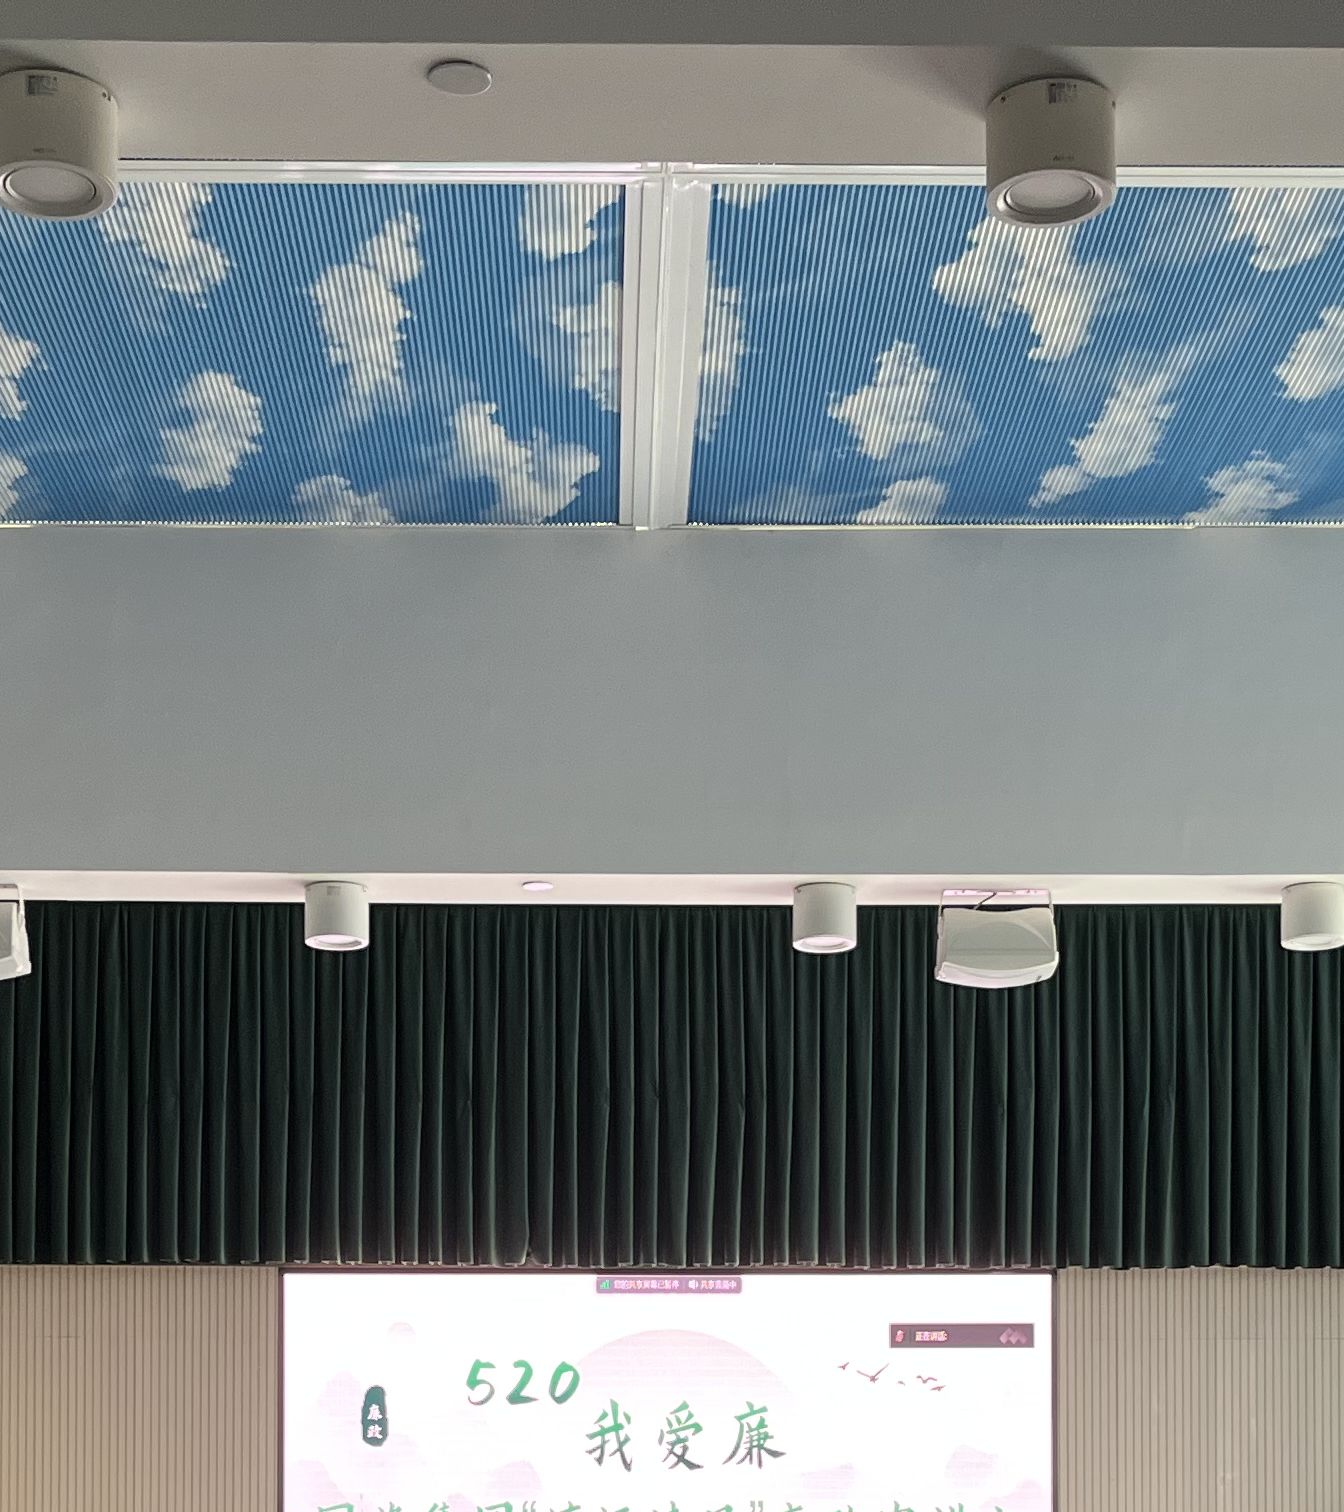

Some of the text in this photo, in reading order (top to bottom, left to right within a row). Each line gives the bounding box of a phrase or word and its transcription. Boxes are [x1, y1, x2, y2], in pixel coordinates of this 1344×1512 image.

[466, 1358, 580, 1405] 520
[585, 1398, 787, 1472] 我爱廉
